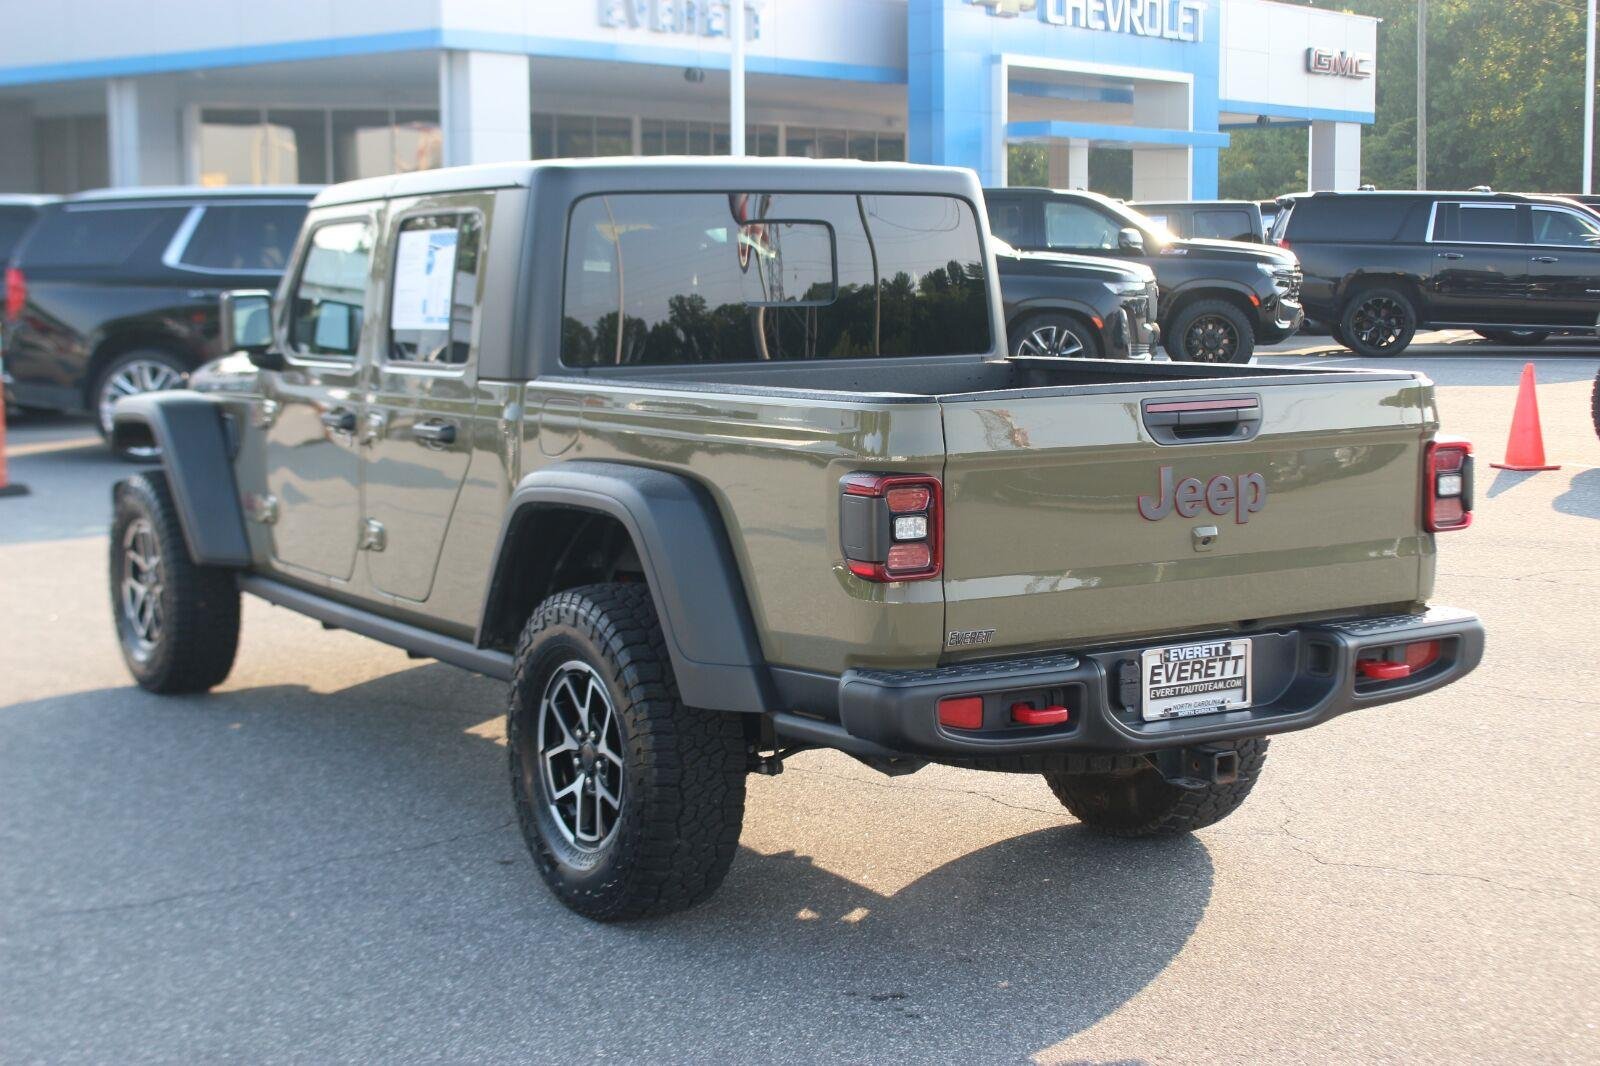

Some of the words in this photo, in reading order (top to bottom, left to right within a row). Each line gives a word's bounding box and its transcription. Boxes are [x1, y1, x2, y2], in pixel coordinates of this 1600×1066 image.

[1041, 0, 1207, 43] CHEVROLET
[1305, 48, 1371, 79] GMC
[1138, 465, 1267, 524] Jeep
[948, 629, 996, 647] EVERETT
[1169, 644, 1226, 661] EVERETT
[1149, 655, 1245, 686] EVERETT
[1150, 679, 1242, 699] EVERETTAUTOTEAM.COM
[1172, 702, 1193, 711] NORTH
[1193, 699, 1221, 708] CAROLINA
[1178, 709, 1195, 717] NORTH
